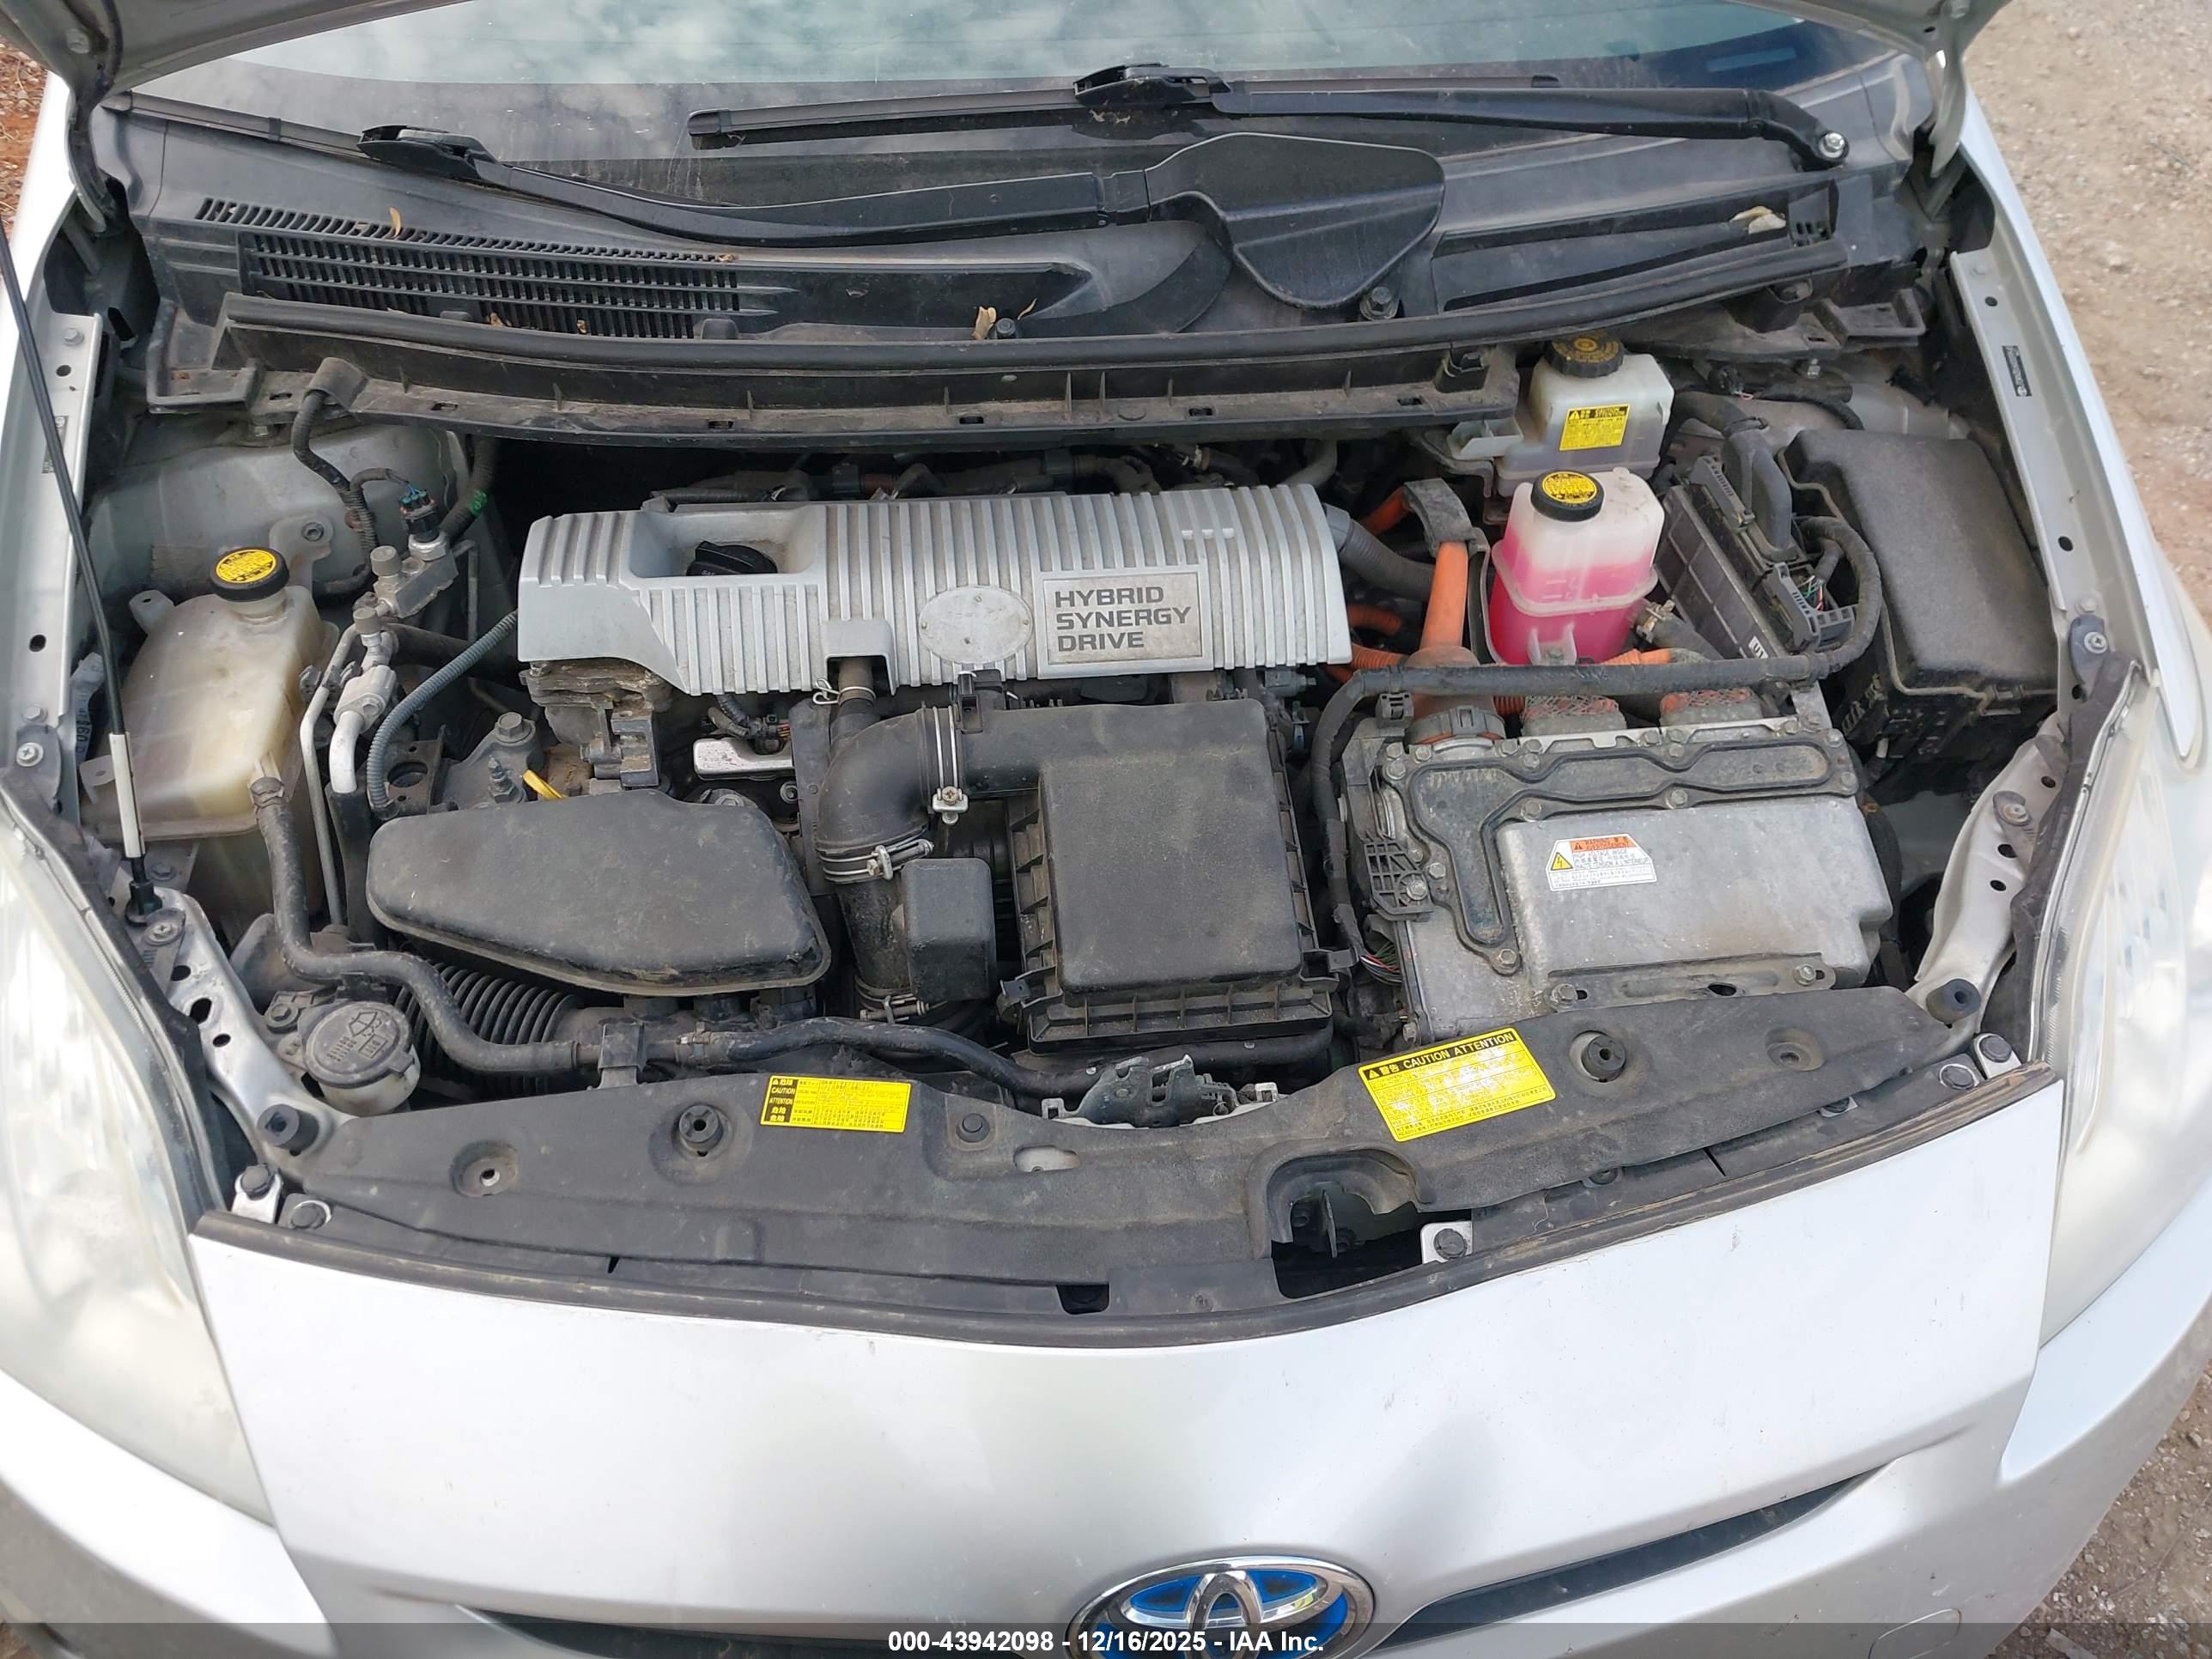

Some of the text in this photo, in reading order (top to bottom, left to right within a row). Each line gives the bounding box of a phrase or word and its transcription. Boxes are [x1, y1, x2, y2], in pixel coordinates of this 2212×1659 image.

[1054, 586, 1164, 608] HYBRID
[1056, 606, 1192, 630] SYNERGY
[1057, 631, 1145, 653] DRIVE
[1403, 1049, 1451, 1069] CAUTION
[1453, 1033, 1515, 1056] ATTENTION
[771, 1086, 796, 1095] CAUTION
